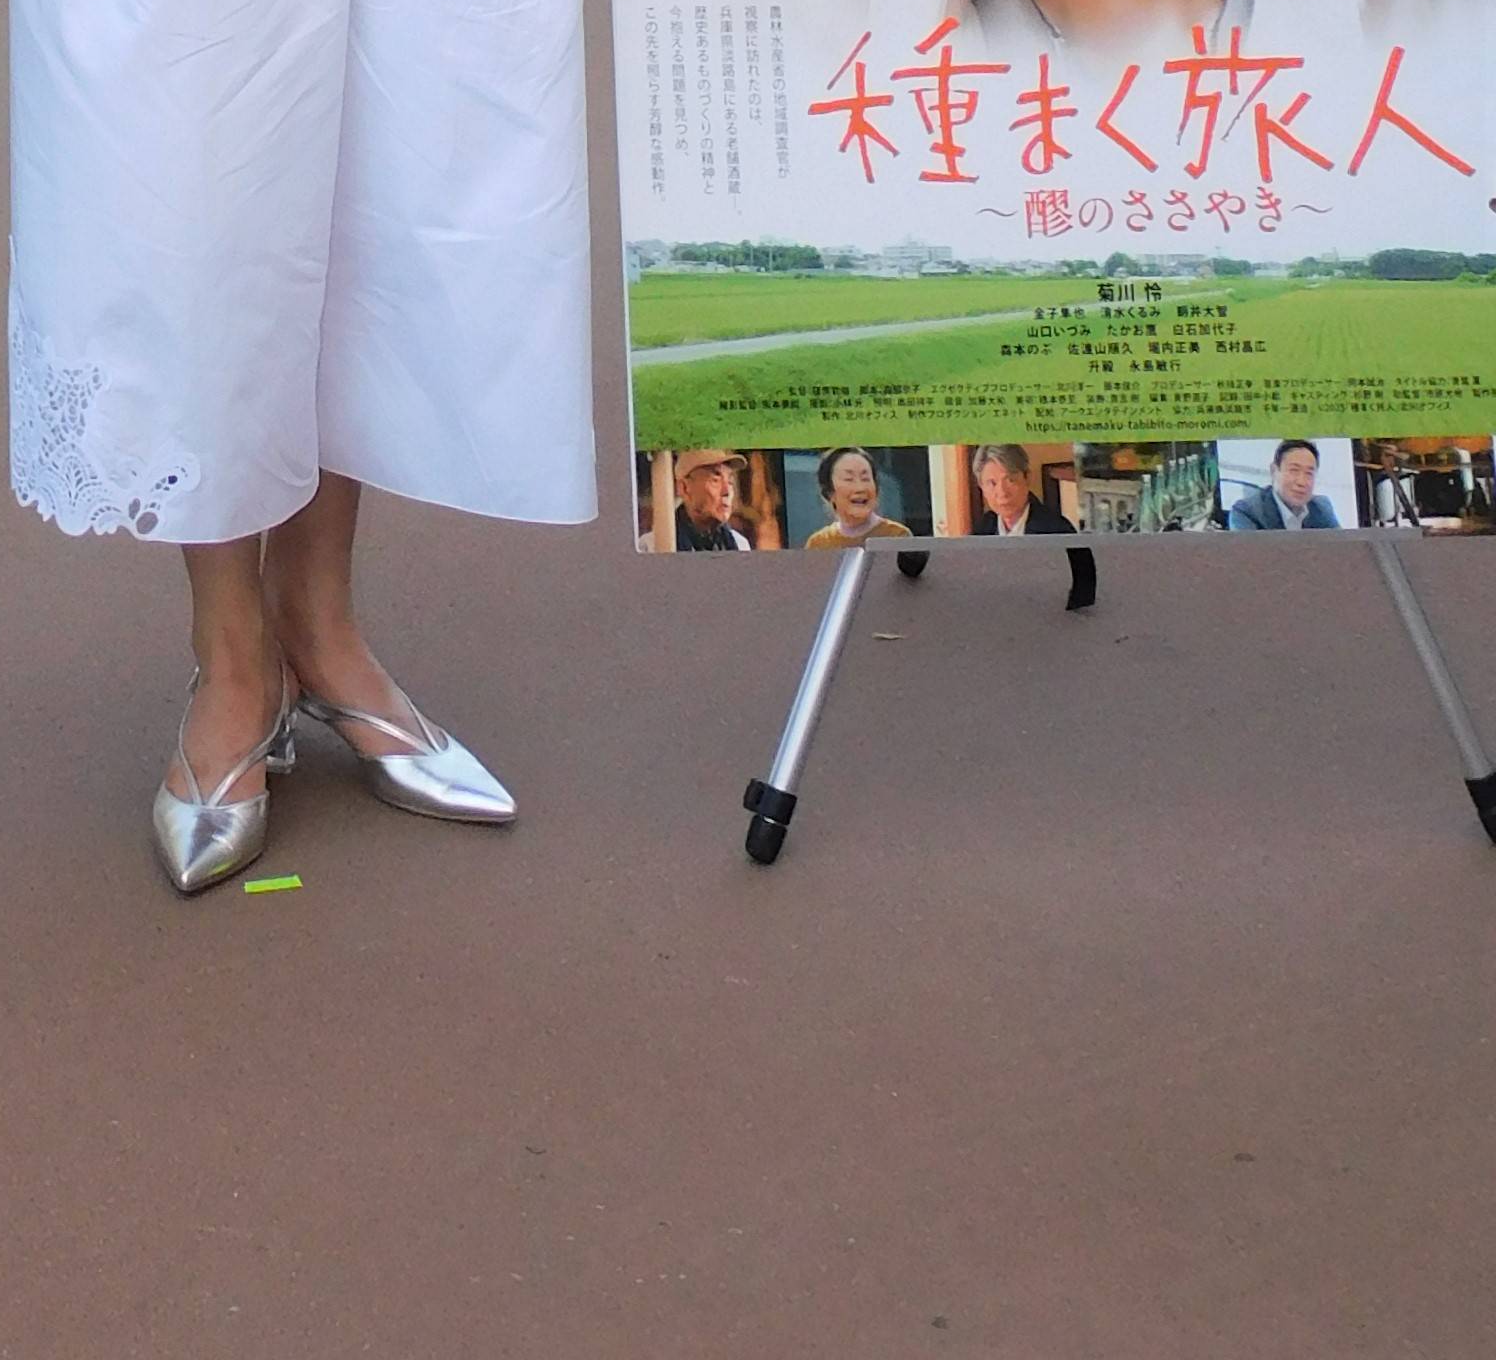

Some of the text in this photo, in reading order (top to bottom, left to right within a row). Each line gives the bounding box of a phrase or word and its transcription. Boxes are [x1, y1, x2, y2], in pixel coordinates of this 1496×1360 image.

[808, 17, 1476, 185] 種まく旅人
